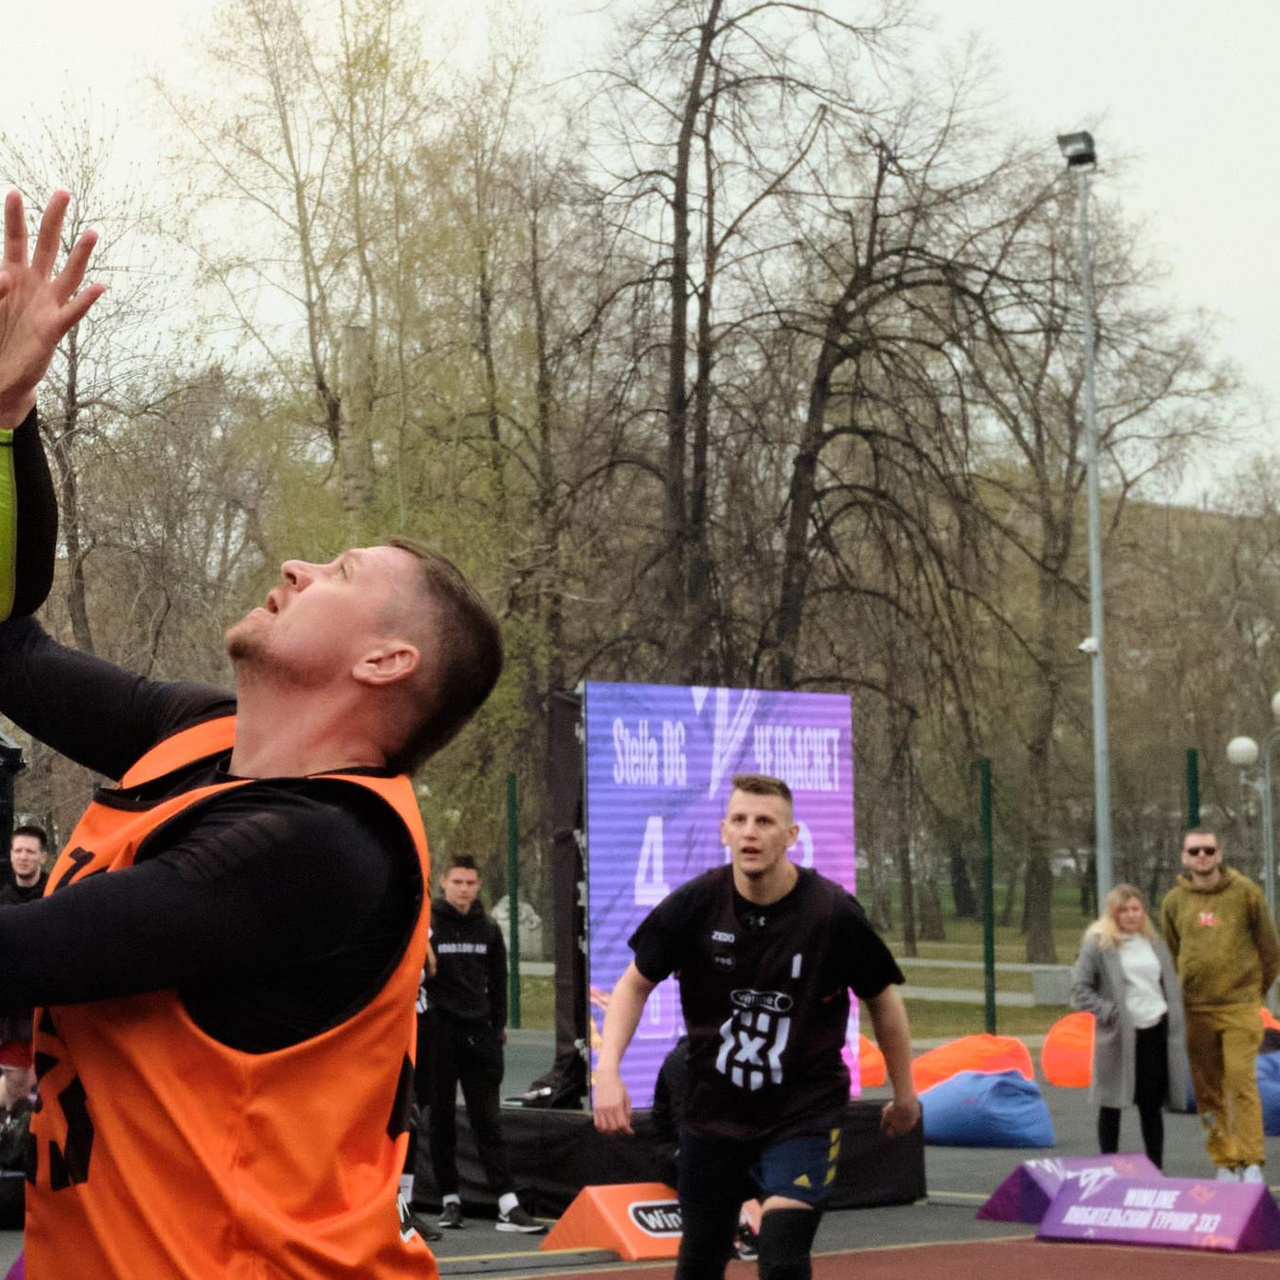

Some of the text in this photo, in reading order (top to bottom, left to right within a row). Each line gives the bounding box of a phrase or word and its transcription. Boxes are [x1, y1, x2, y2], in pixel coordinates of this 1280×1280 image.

[613, 717, 658, 786] Stella
[635, 816, 671, 906] 4
[791, 953, 802, 978] 1
[638, 1208, 682, 1229] Win
